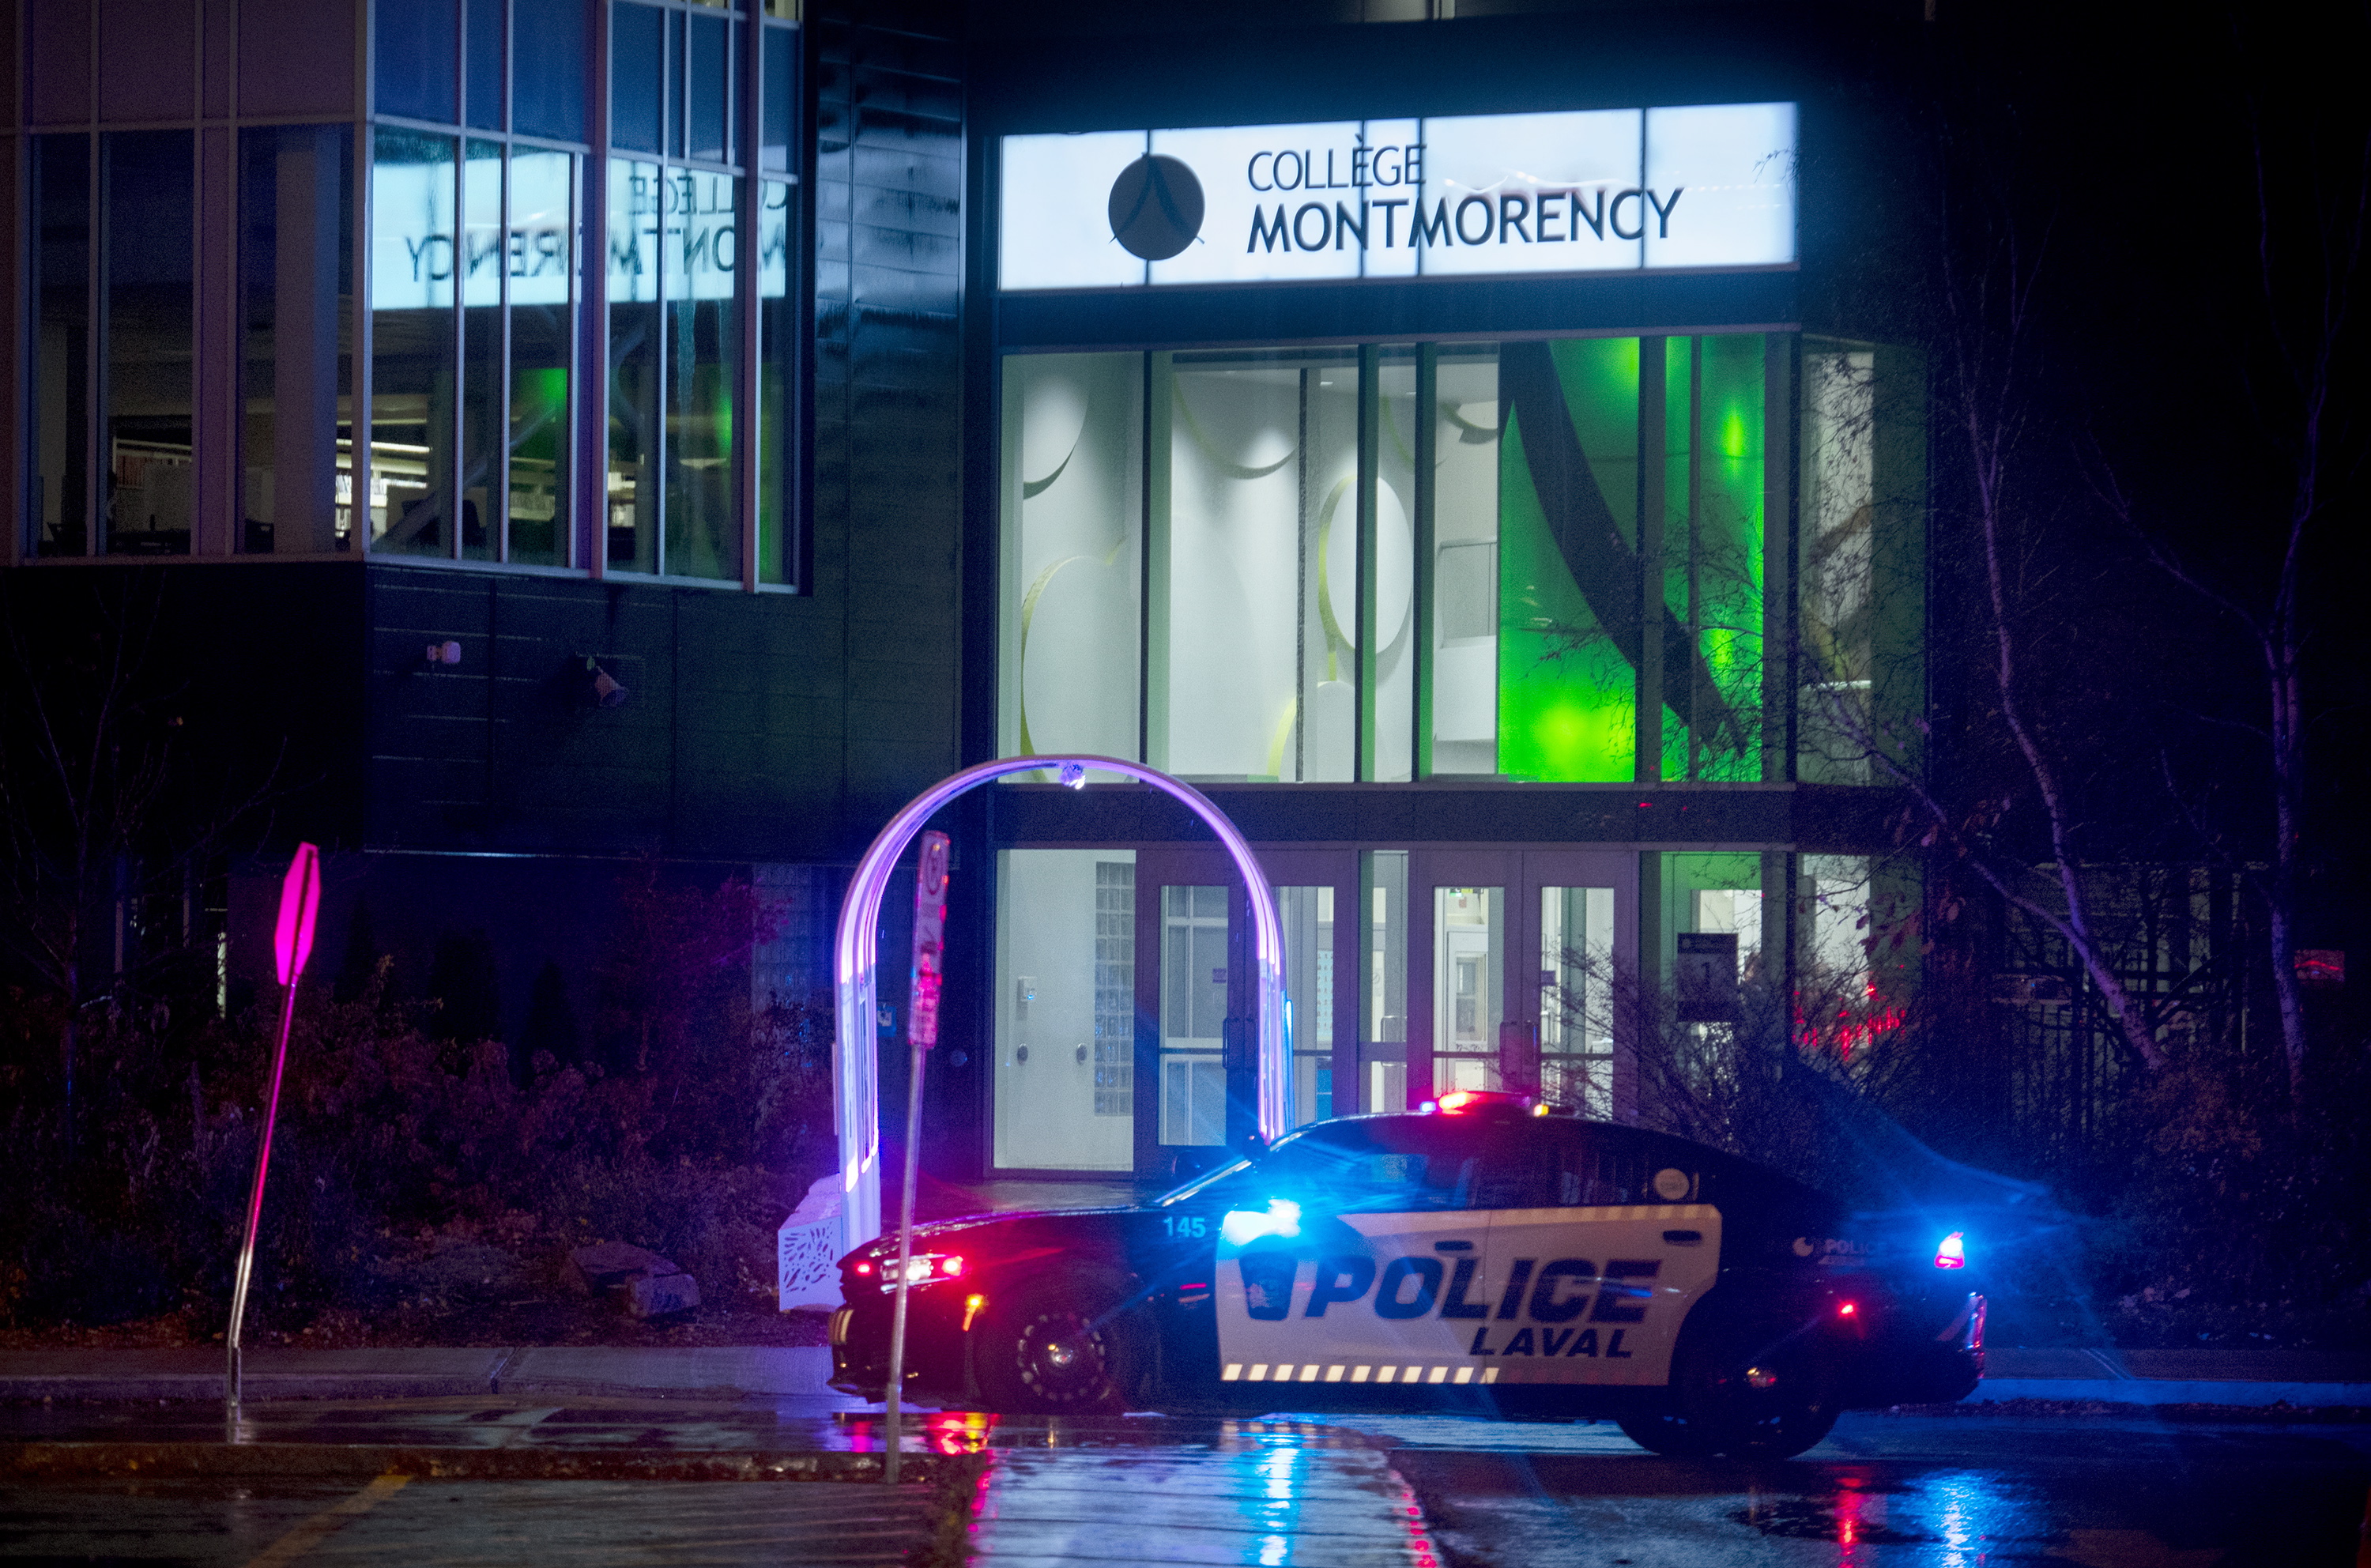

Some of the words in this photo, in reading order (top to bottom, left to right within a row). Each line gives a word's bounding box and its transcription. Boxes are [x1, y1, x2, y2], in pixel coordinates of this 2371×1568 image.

[1248, 133, 1427, 191] COLLÈGE
[1247, 187, 1685, 253] MONTMORENCY
[1163, 1217, 1206, 1238] 145
[1305, 1257, 1661, 1323] POLICE
[1469, 1327, 1633, 1359] LAVAL
